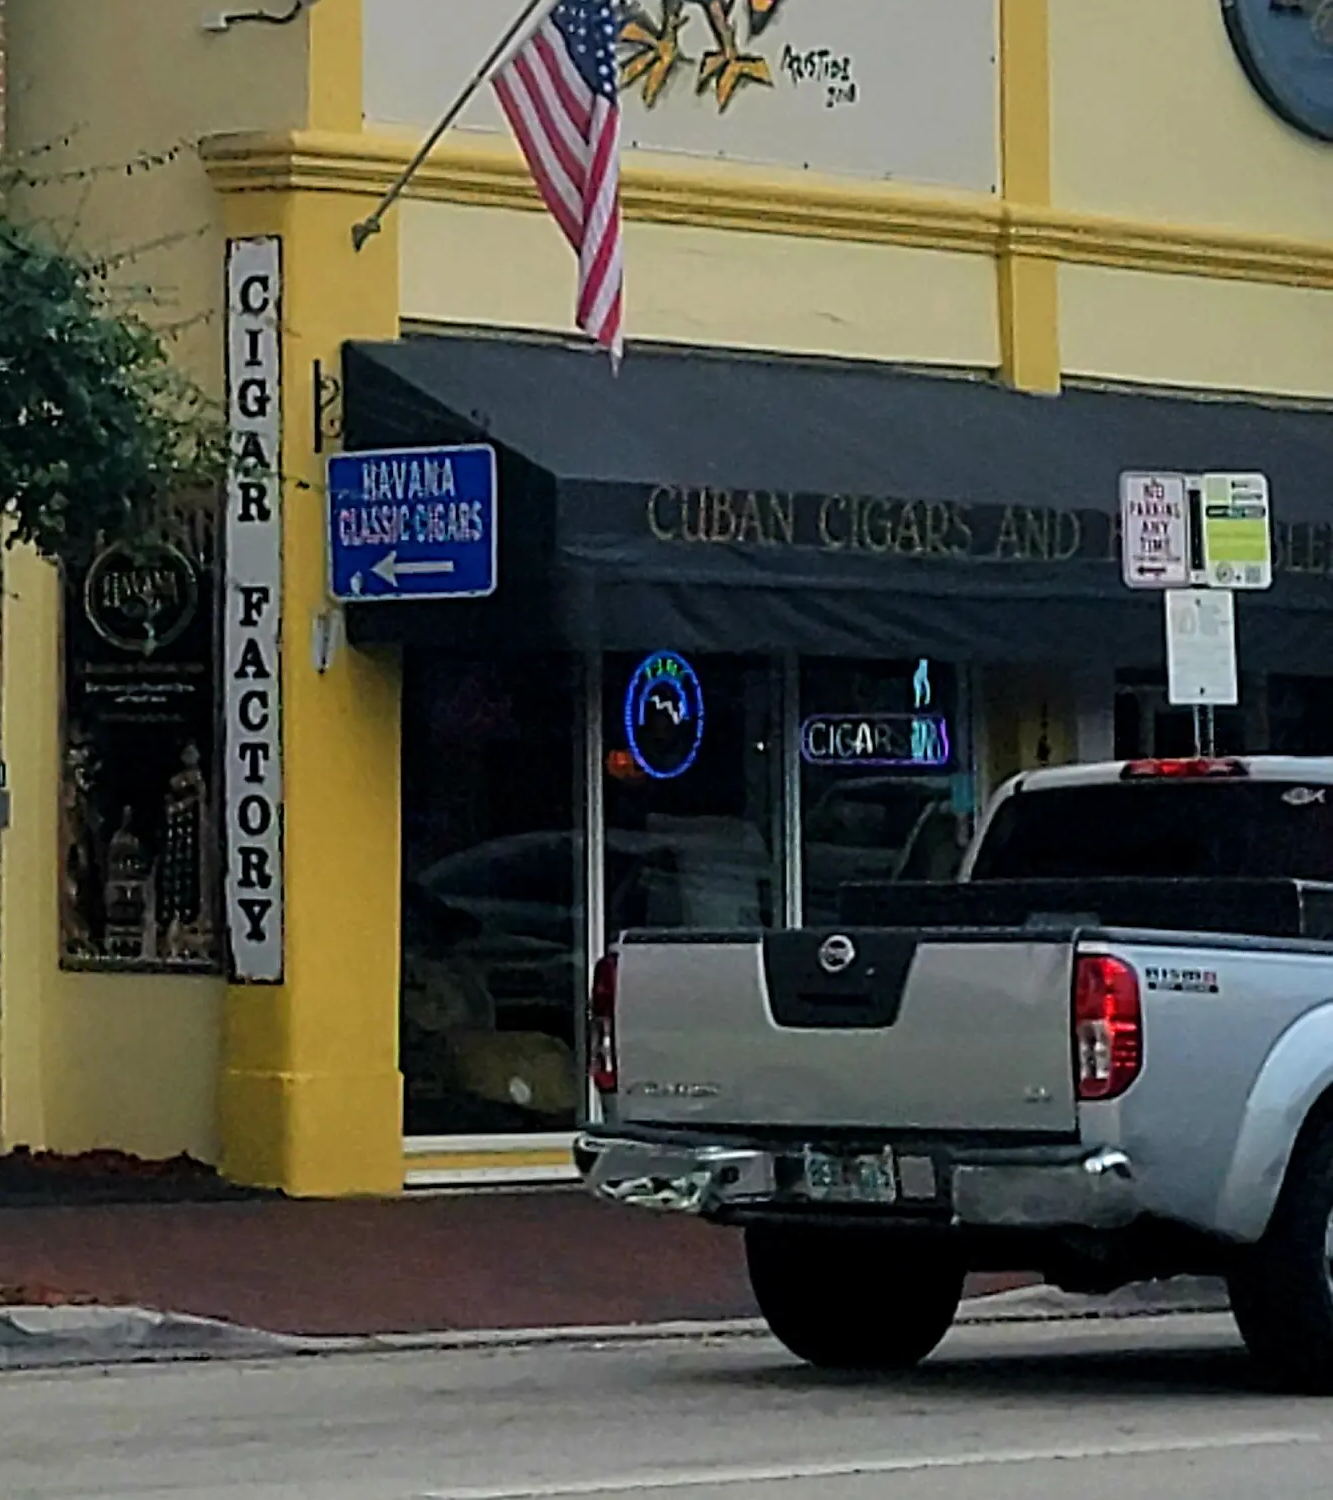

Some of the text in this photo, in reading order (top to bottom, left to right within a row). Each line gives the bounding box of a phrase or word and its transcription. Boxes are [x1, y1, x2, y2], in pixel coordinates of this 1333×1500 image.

[237, 275, 271, 522] CIGAR
[362, 456, 456, 500] HAVANA
[339, 500, 483, 547] CLASSIC CIGARS
[645, 484, 793, 546] CUBAN
[818, 493, 973, 556] CIGARS
[995, 503, 1080, 561] AND
[234, 585, 272, 943] FACTORY
